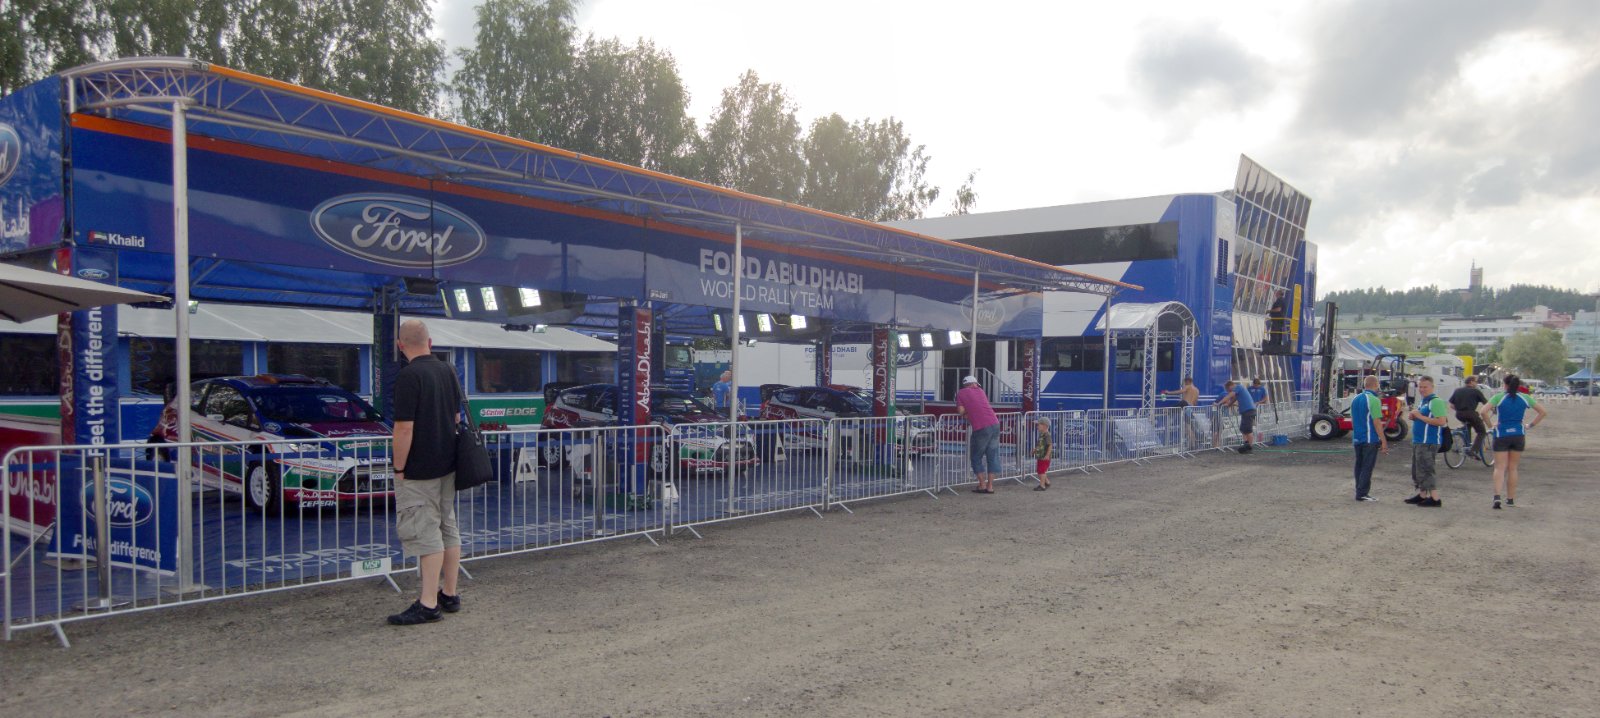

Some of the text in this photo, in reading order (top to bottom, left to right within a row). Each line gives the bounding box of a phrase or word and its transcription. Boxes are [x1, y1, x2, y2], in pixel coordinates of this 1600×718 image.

[108, 233, 145, 248] Khalid
[351, 203, 455, 257] Ford
[700, 249, 864, 295] FORD ABU DHABI
[759, 286, 798, 306] RALLY
[800, 291, 834, 310] TEAM
[84, 305, 105, 457] Feel the differen
[506, 407, 537, 416] EDGE
